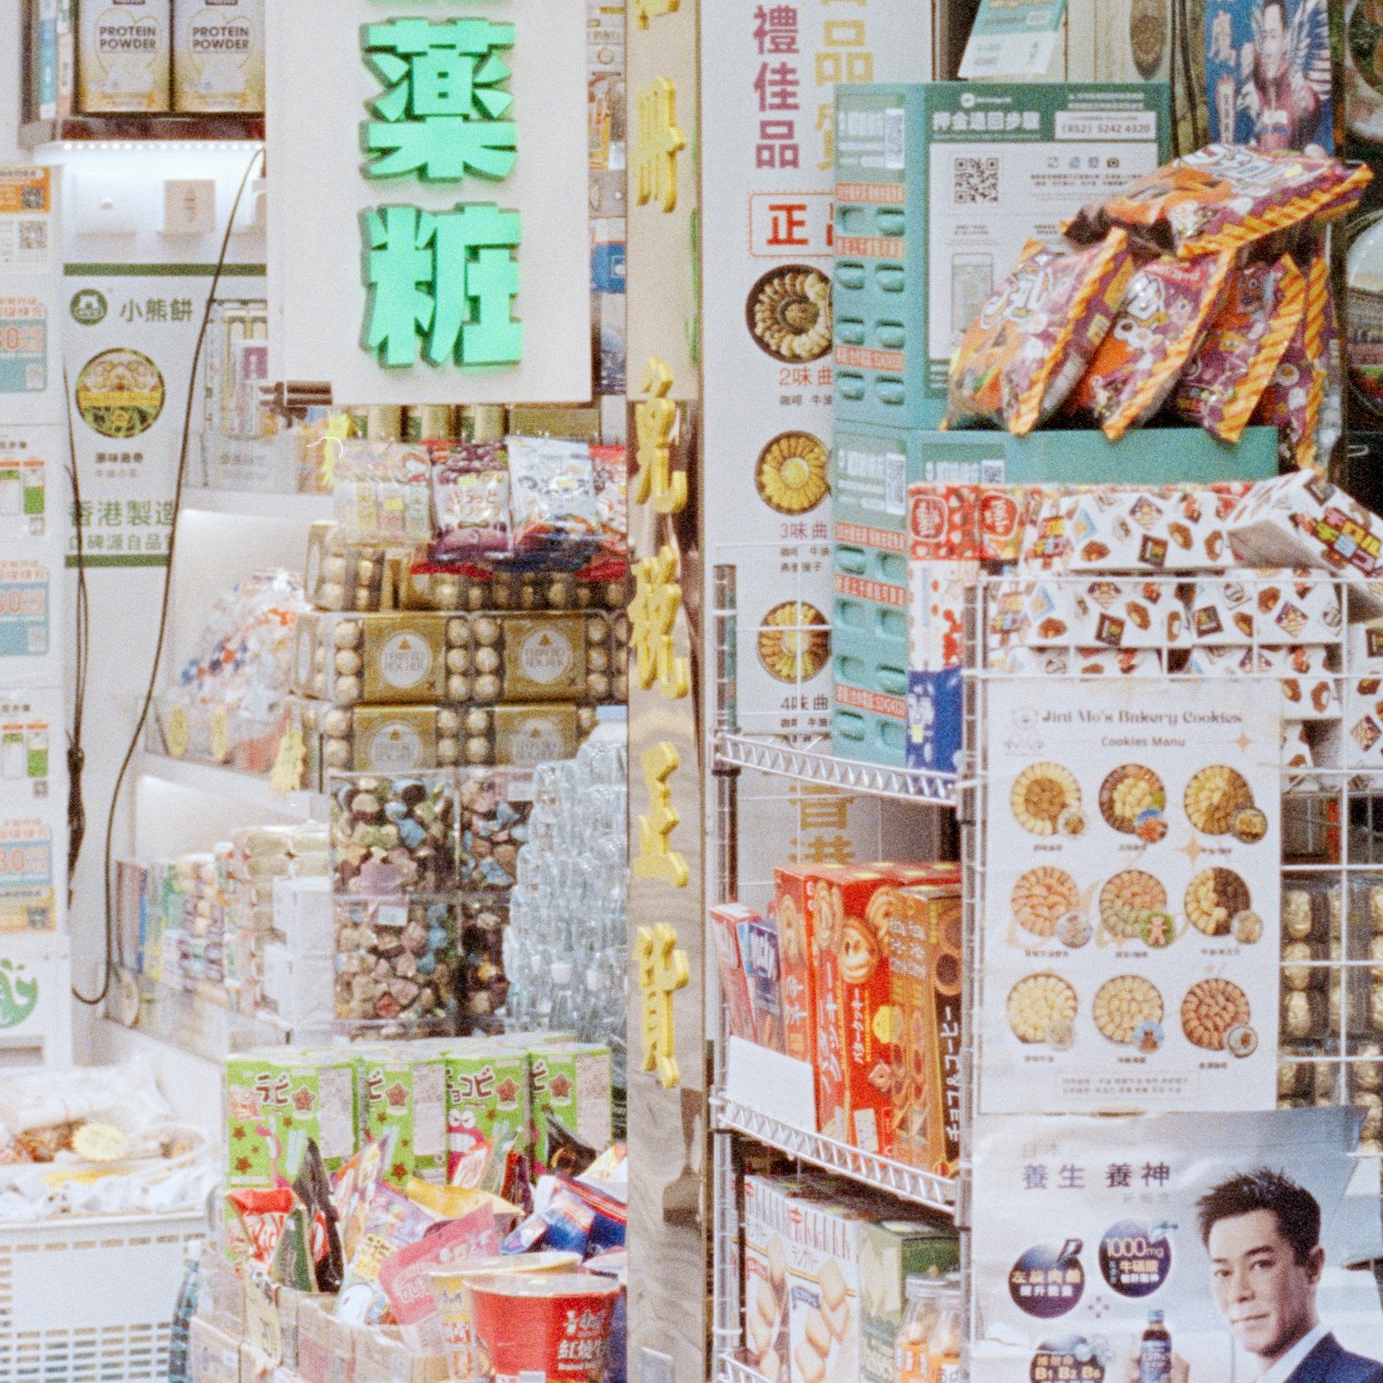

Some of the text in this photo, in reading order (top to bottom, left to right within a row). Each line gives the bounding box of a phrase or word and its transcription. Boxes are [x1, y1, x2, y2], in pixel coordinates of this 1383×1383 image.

[99, 25, 156, 37] PROTEIN
[192, 25, 249, 37] PROTEIN
[99, 38, 156, 50] POWDER
[192, 38, 249, 50] POWDER
[1060, 123, 1093, 136] (852)
[119, 297, 194, 324] 小熊餅
[69, 499, 177, 528] 香港製造
[1118, 710, 1178, 726] Bakery
[1182, 710, 1243, 723] Cookies
[1101, 736, 1148, 747] Cookies
[1023, 1162, 1172, 1190] 養生 養神
